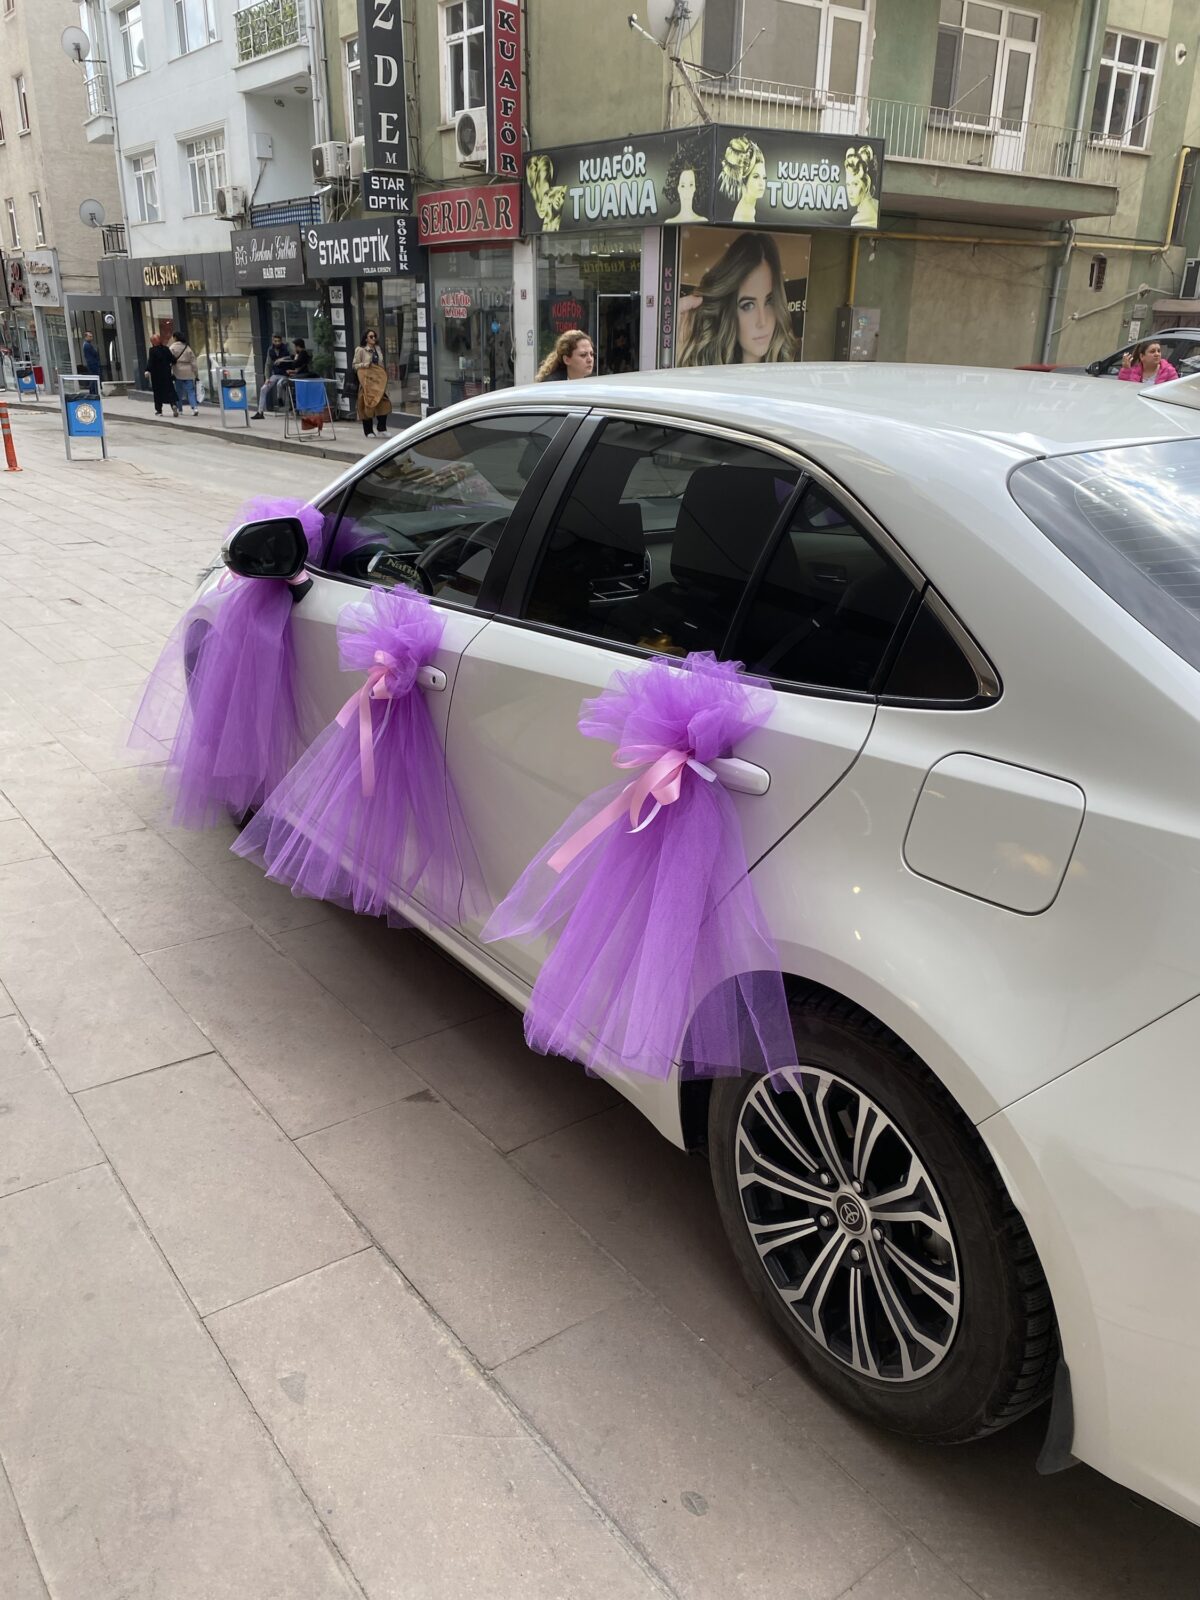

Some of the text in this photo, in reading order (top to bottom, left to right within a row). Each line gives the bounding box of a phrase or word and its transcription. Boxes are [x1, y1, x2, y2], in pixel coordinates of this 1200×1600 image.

[497, 10, 518, 173] KUAFÖR
[579, 146, 647, 182] KUAFÖR
[777, 159, 840, 182] KUAFÖR
[369, 193, 410, 211] OPTİK
[371, 176, 405, 191] STAR
[569, 179, 658, 222] TUANA
[767, 181, 849, 211] TUANA
[420, 195, 514, 237] SERDAR
[319, 228, 391, 265] STAR OPTİK
[396, 218, 409, 271] GÖZLÜK
[663, 267, 673, 349] KUAFÖR
